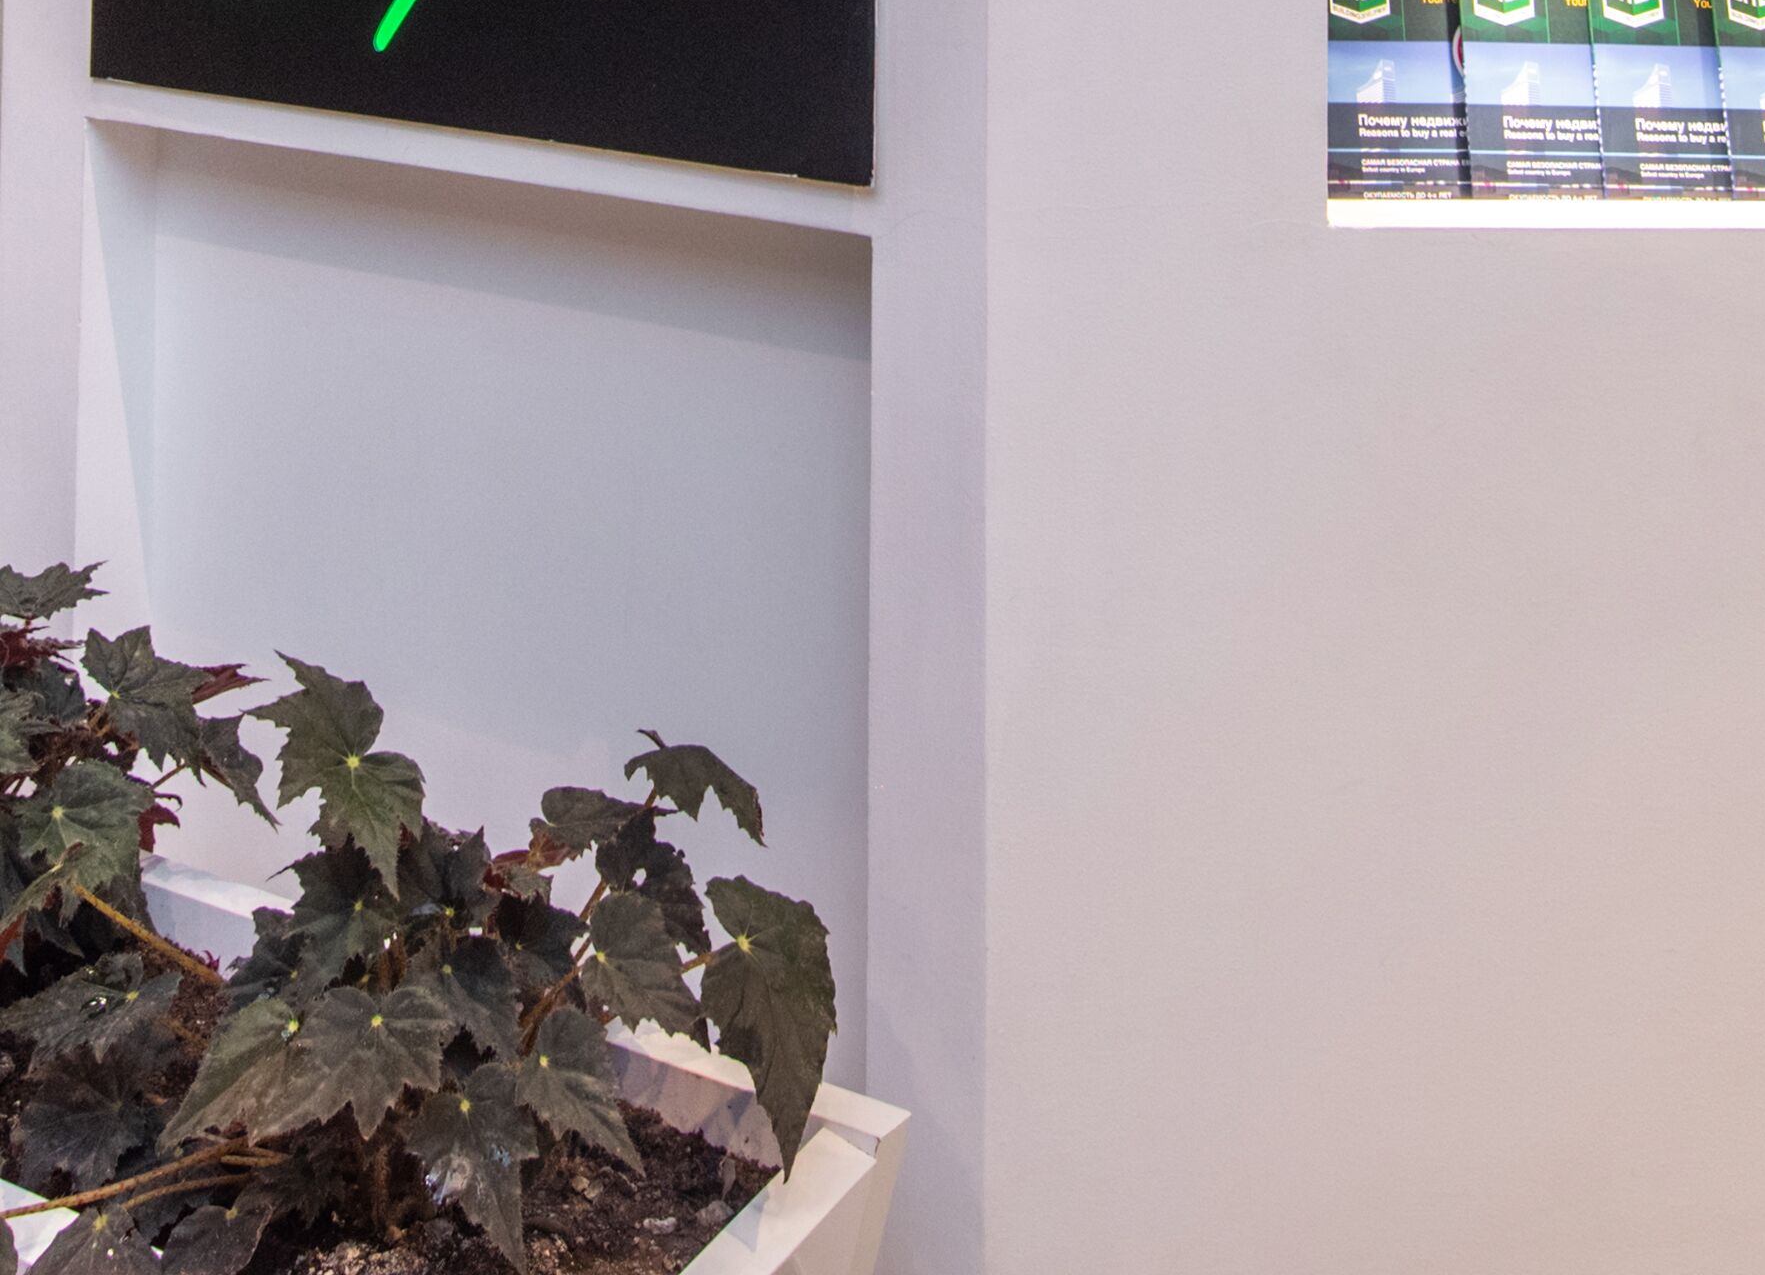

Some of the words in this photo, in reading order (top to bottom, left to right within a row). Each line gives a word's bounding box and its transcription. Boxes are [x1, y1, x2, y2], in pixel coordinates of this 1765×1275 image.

[1358, 114, 1407, 129] Почему
[1503, 115, 1552, 130] Почему
[1635, 118, 1685, 133] Почему
[1359, 127, 1399, 138] Reasons
[1401, 128, 1412, 138] to
[1412, 128, 1430, 140] buy
[1431, 130, 1439, 138] a
[1439, 128, 1457, 138] real
[1545, 131, 1555, 140] to
[1557, 130, 1575, 142] buy
[1678, 133, 1688, 143] to
[1689, 133, 1707, 145] buy
